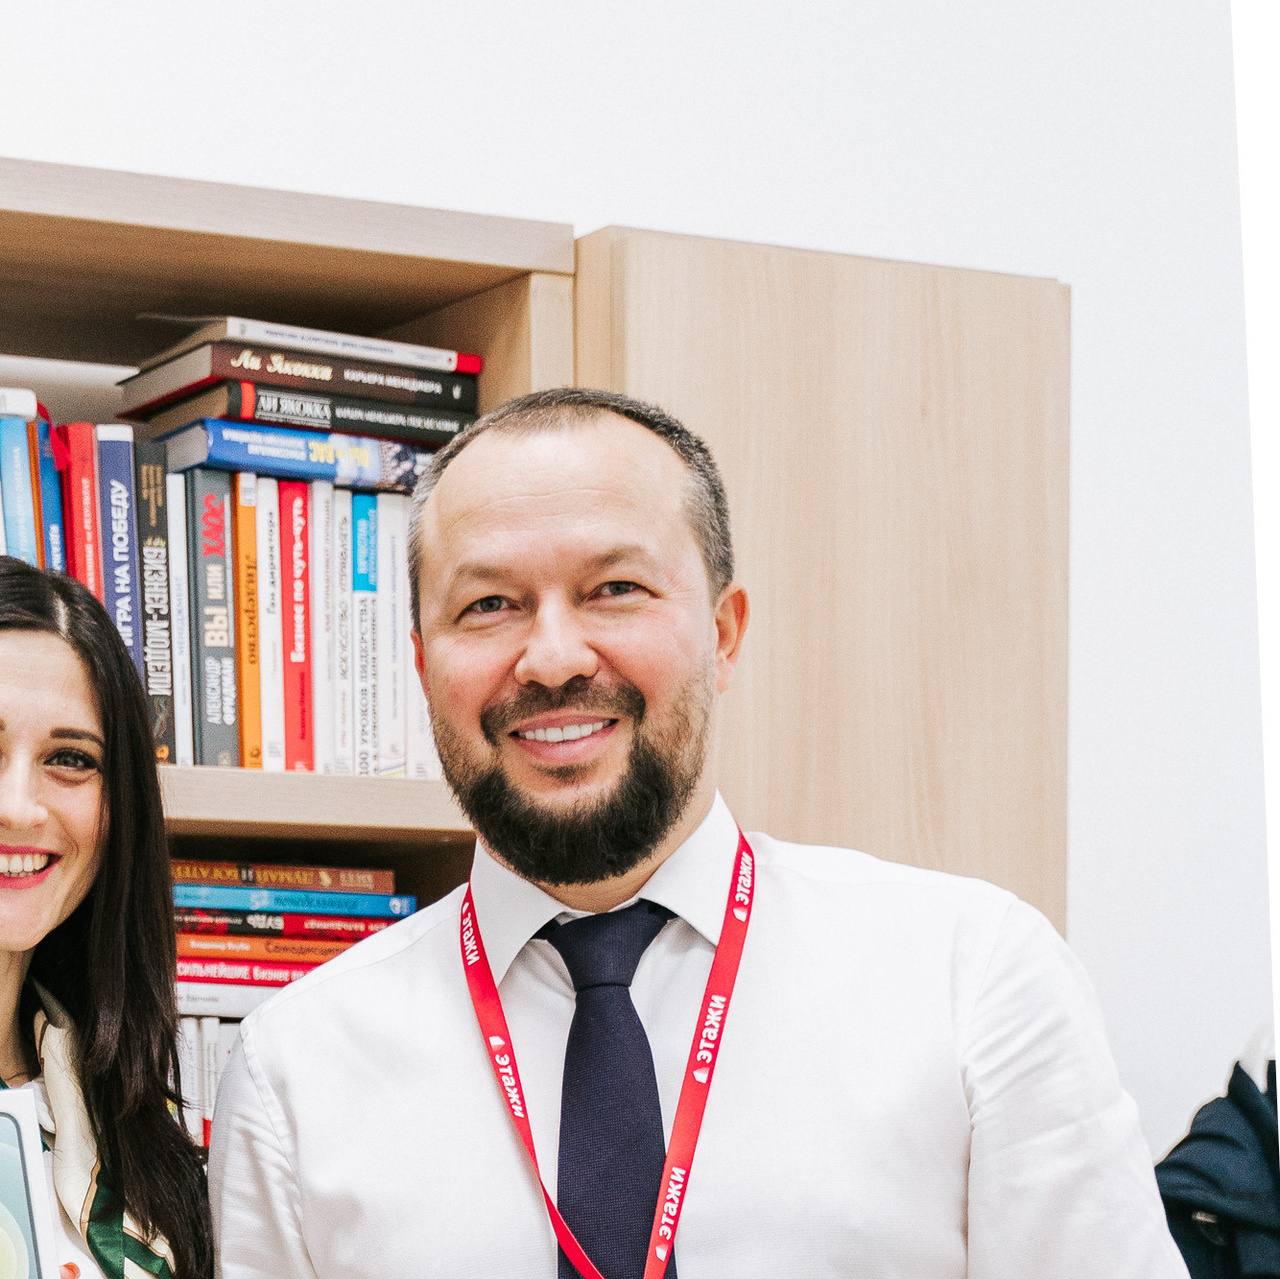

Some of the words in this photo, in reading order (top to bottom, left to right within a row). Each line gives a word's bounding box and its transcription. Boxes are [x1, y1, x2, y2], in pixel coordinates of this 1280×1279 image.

[230, 346, 263, 370] Ли
[259, 394, 278, 412] ЛИ
[276, 397, 332, 421] ЯКОККА
[110, 478, 132, 561] ПОБЕДУ
[291, 496, 305, 578] чуть-чуть
[115, 563, 131, 593] НА
[205, 563, 224, 599] ИЛИ
[293, 579, 303, 601] по
[116, 594, 128, 646] ИГРА
[202, 605, 230, 647] ВЫ
[290, 602, 305, 662] Бизнес
[357, 597, 368, 682] ЛИДЕРСТВА
[205, 656, 222, 725] АЛЕКСАНДР
[220, 657, 236, 725] ФРИДМАН
[359, 688, 368, 744] УРОКОВ
[359, 752, 369, 775] 100
[735, 851, 754, 904] этажи
[461, 911, 481, 966] этажи
[696, 994, 727, 1065] этажи
[494, 1054, 525, 1119] этажи
[659, 1167, 687, 1240] этажи
